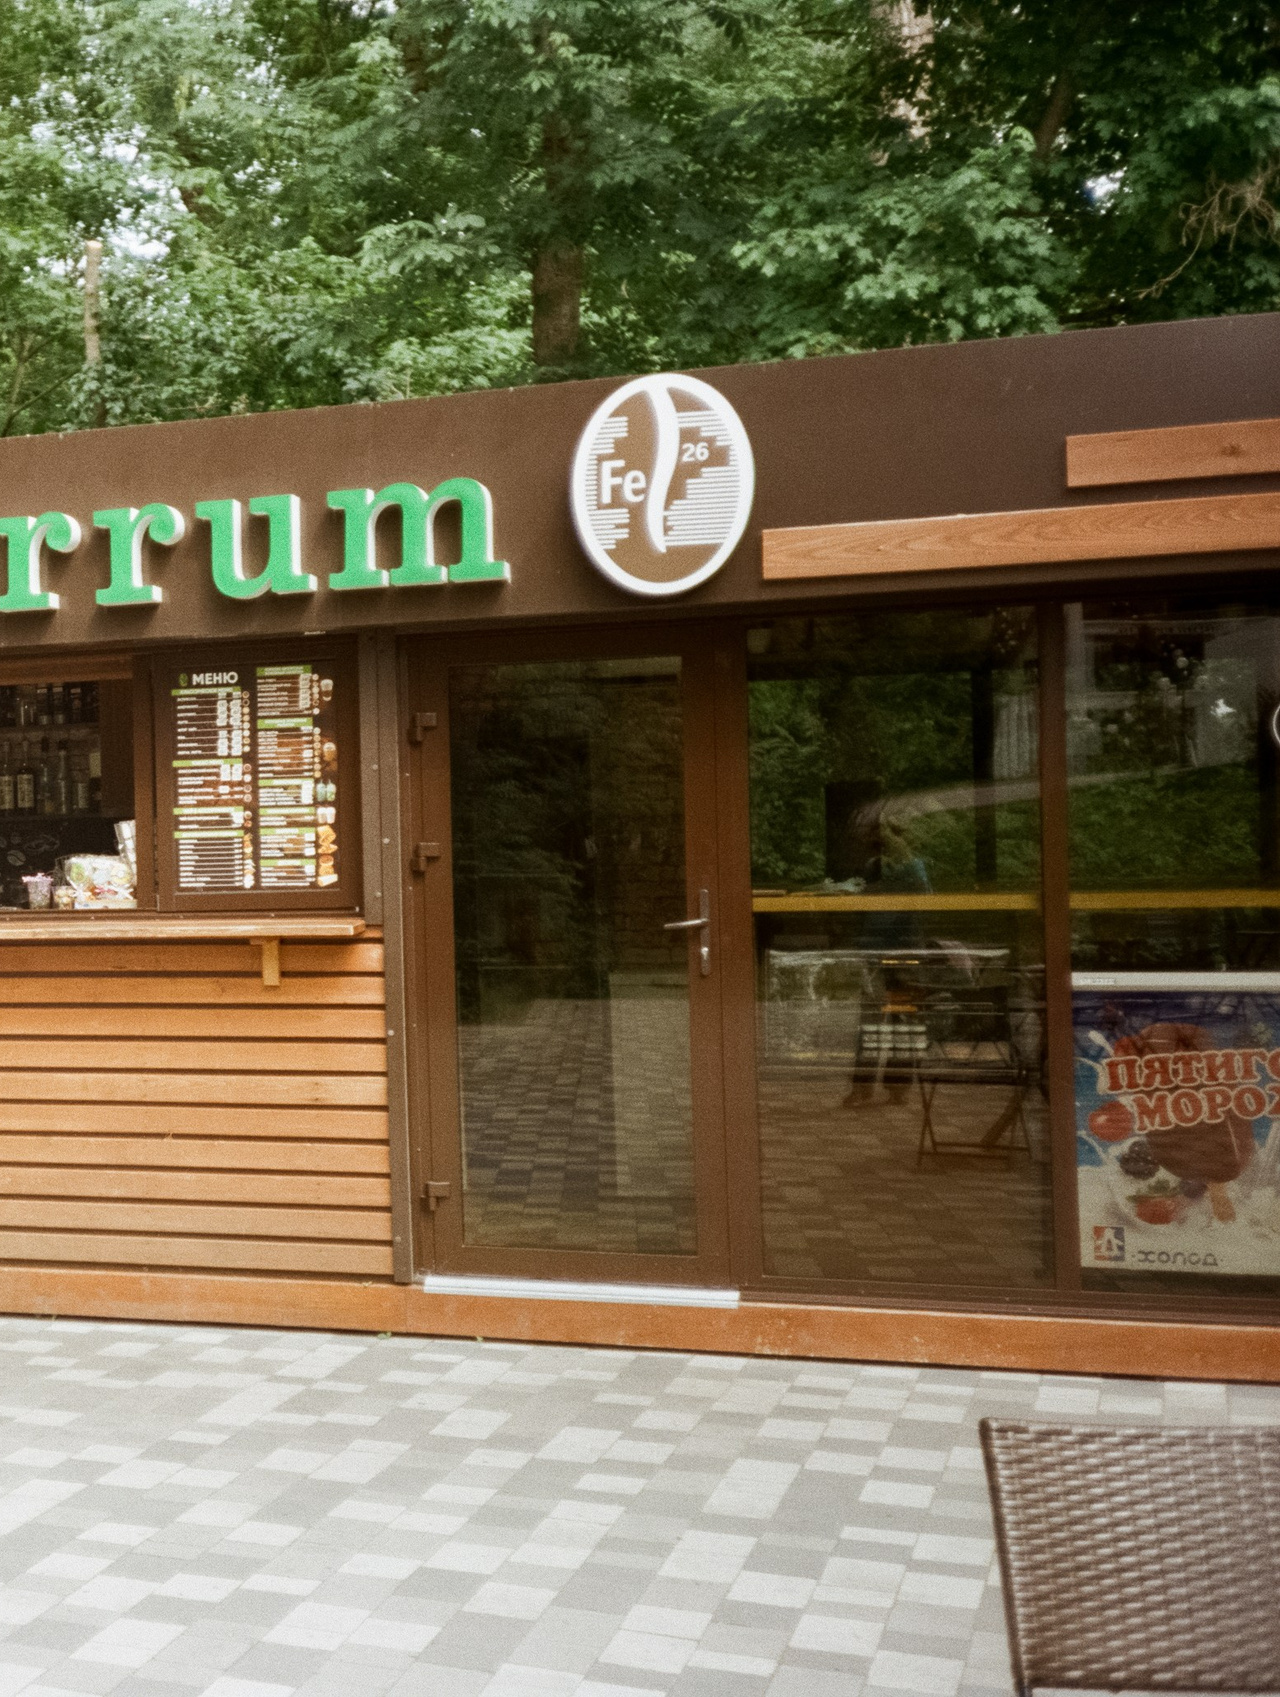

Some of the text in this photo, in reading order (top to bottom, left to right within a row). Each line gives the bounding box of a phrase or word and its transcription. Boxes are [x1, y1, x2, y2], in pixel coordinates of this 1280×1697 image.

[681, 441, 710, 463] 26
[600, 459, 647, 505] Fe
[191, 671, 239, 686] МЕНЮ
